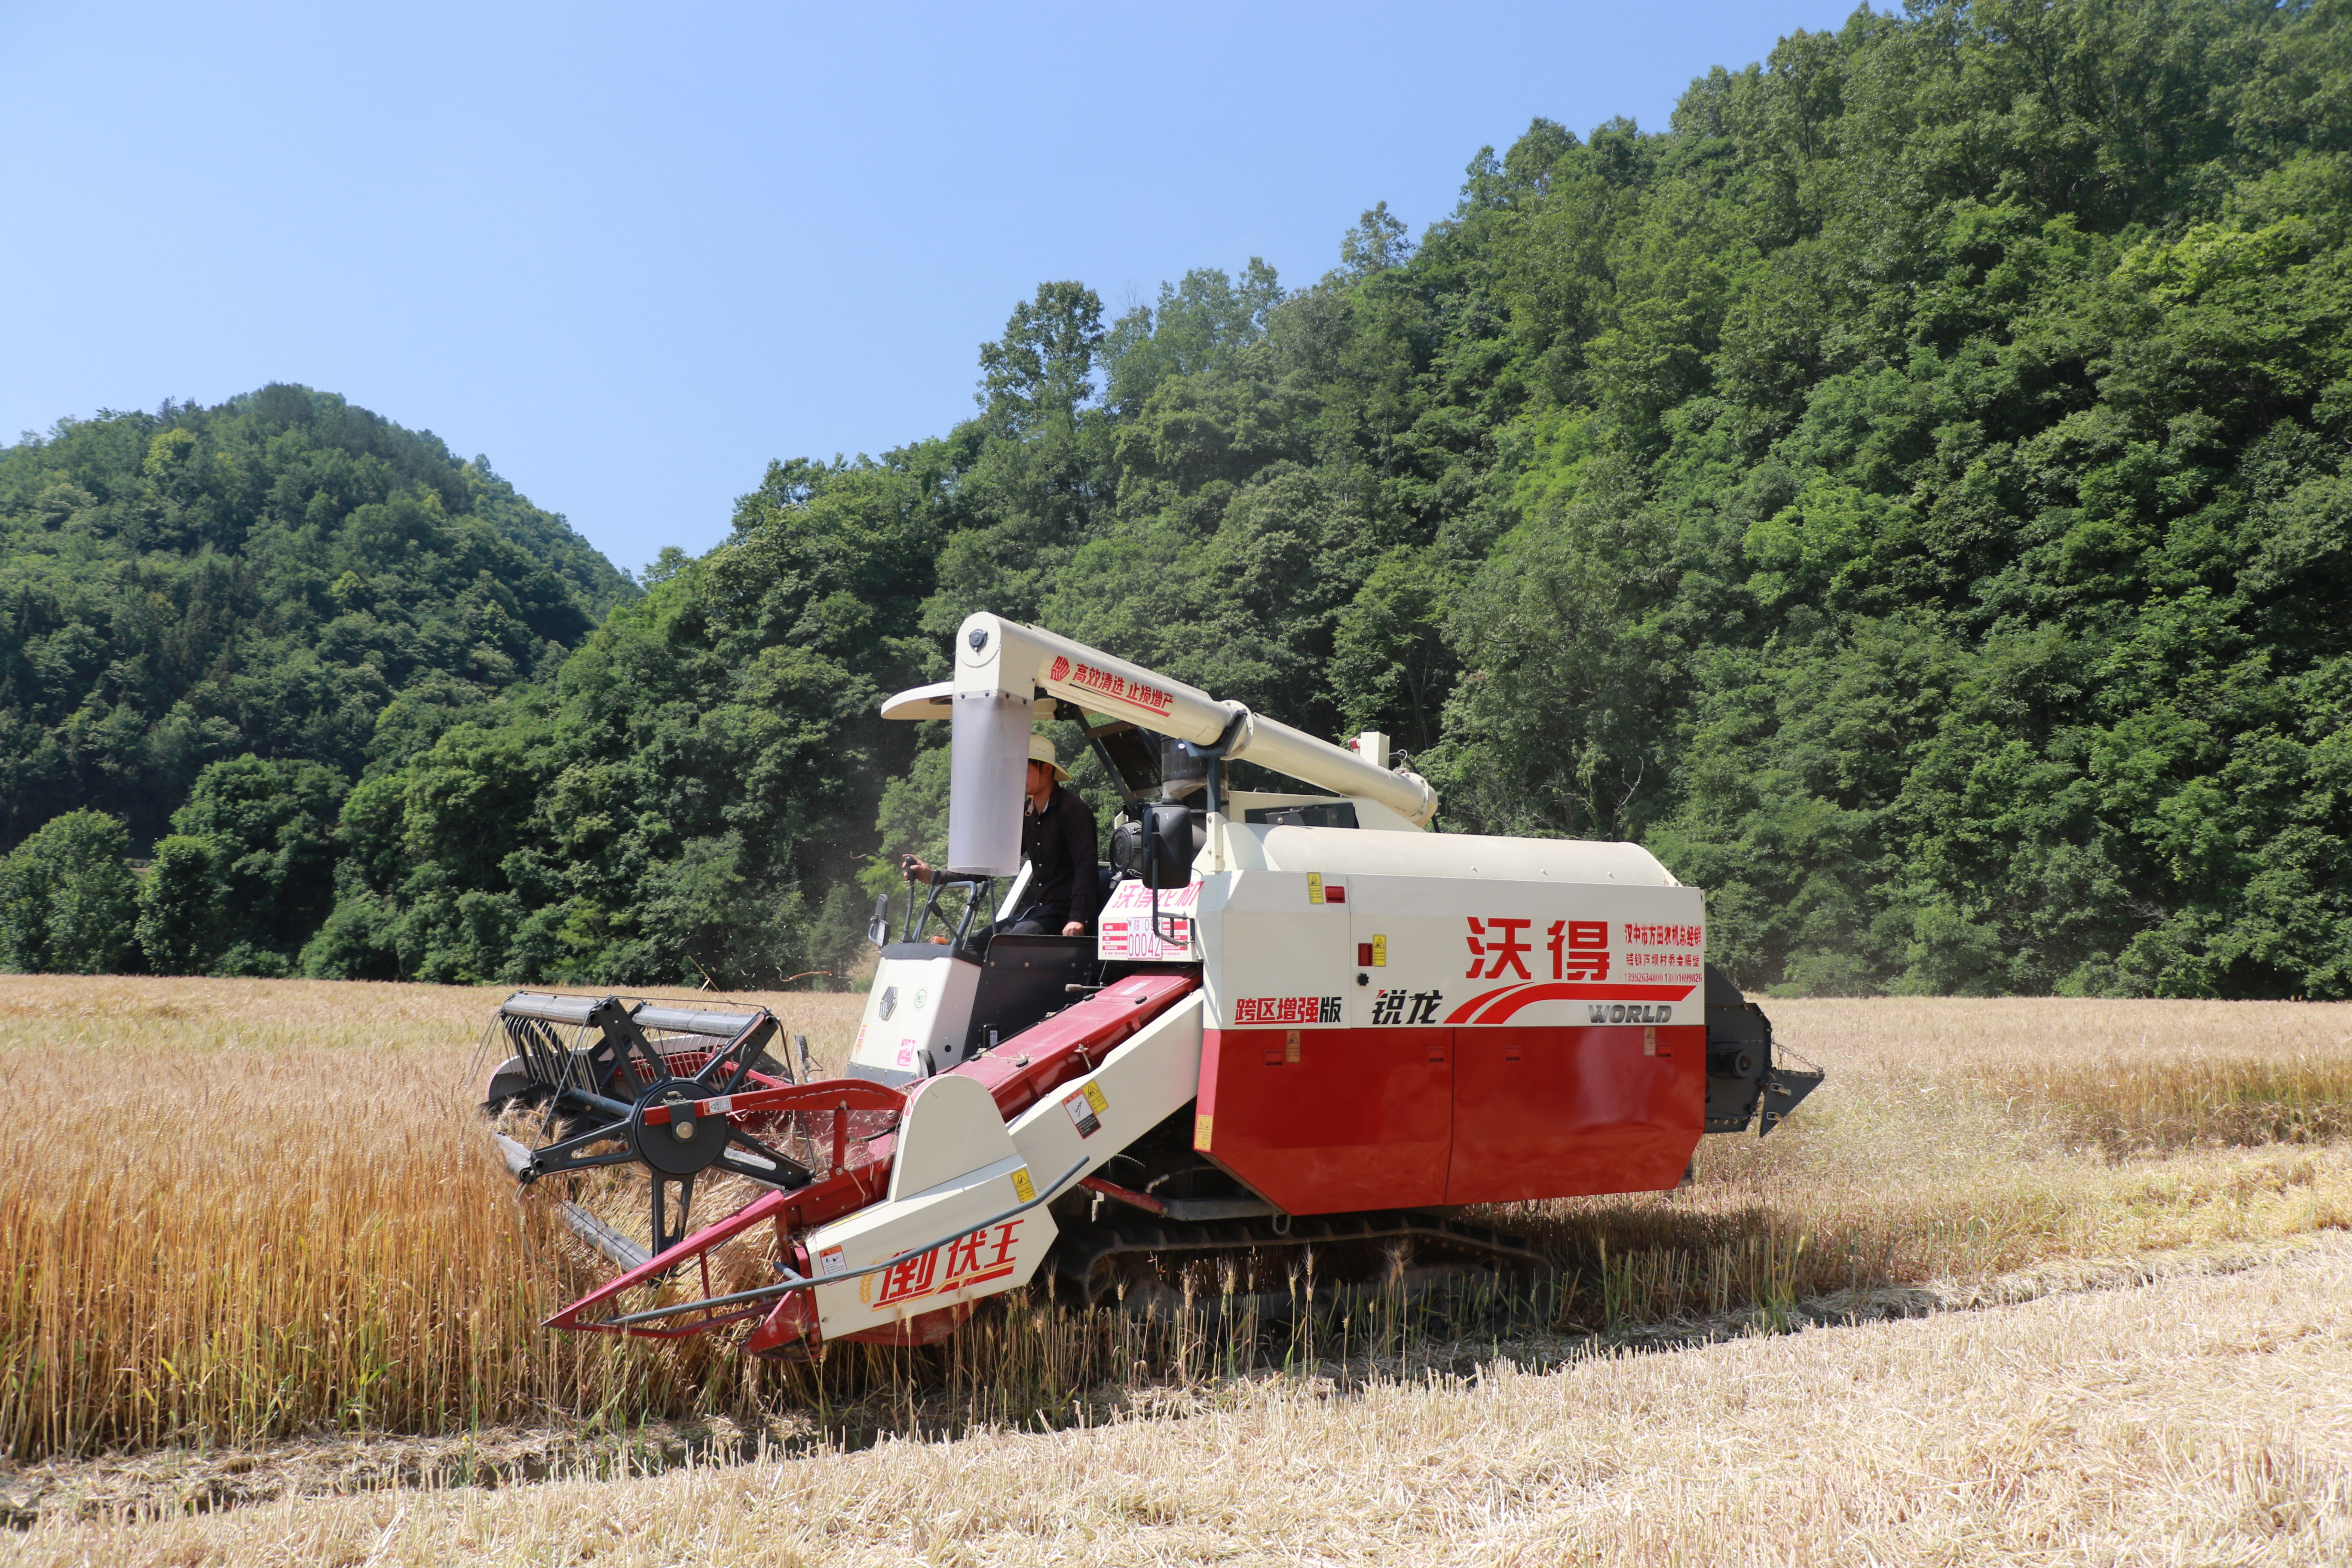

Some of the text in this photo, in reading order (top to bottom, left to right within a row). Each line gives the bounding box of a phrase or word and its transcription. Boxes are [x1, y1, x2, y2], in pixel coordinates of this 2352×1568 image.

[1072, 663, 1173, 708] 高效清选 止损增产
[1134, 919, 1140, 931] 陕
[1128, 933, 1160, 957] 00042
[1466, 916, 1610, 981] 沃得
[1235, 996, 1342, 1023] 跨区增强版
[1372, 989, 1443, 1025] 锐龙
[1588, 1004, 1672, 1023] WORLD
